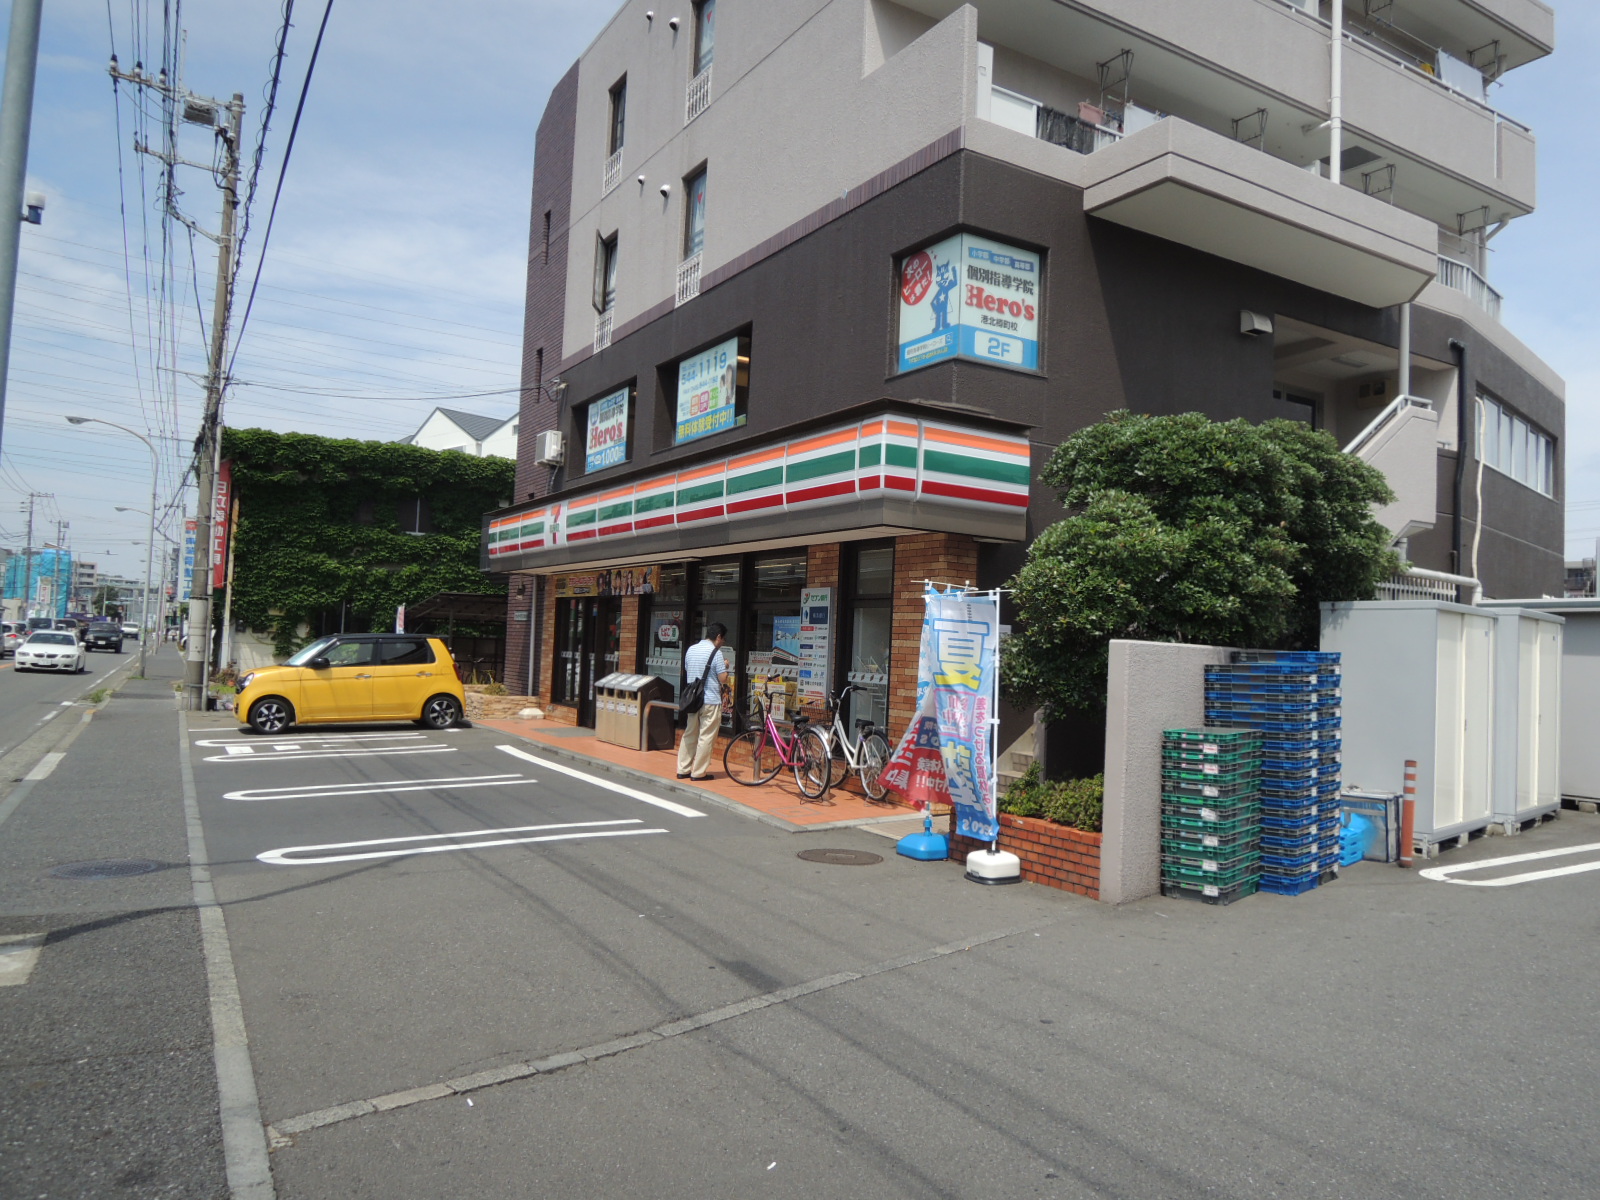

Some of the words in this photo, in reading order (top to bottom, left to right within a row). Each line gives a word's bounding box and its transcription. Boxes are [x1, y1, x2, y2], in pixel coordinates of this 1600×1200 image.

[903, 260, 928, 296] ヒーロー
[905, 259, 919, 279] 次の
[967, 264, 1034, 296] 個別指導学院
[965, 283, 1035, 321] Hero's
[980, 314, 1018, 331] 港北樽町校
[988, 337, 1011, 357] 2F
[588, 414, 623, 449] Hero's
